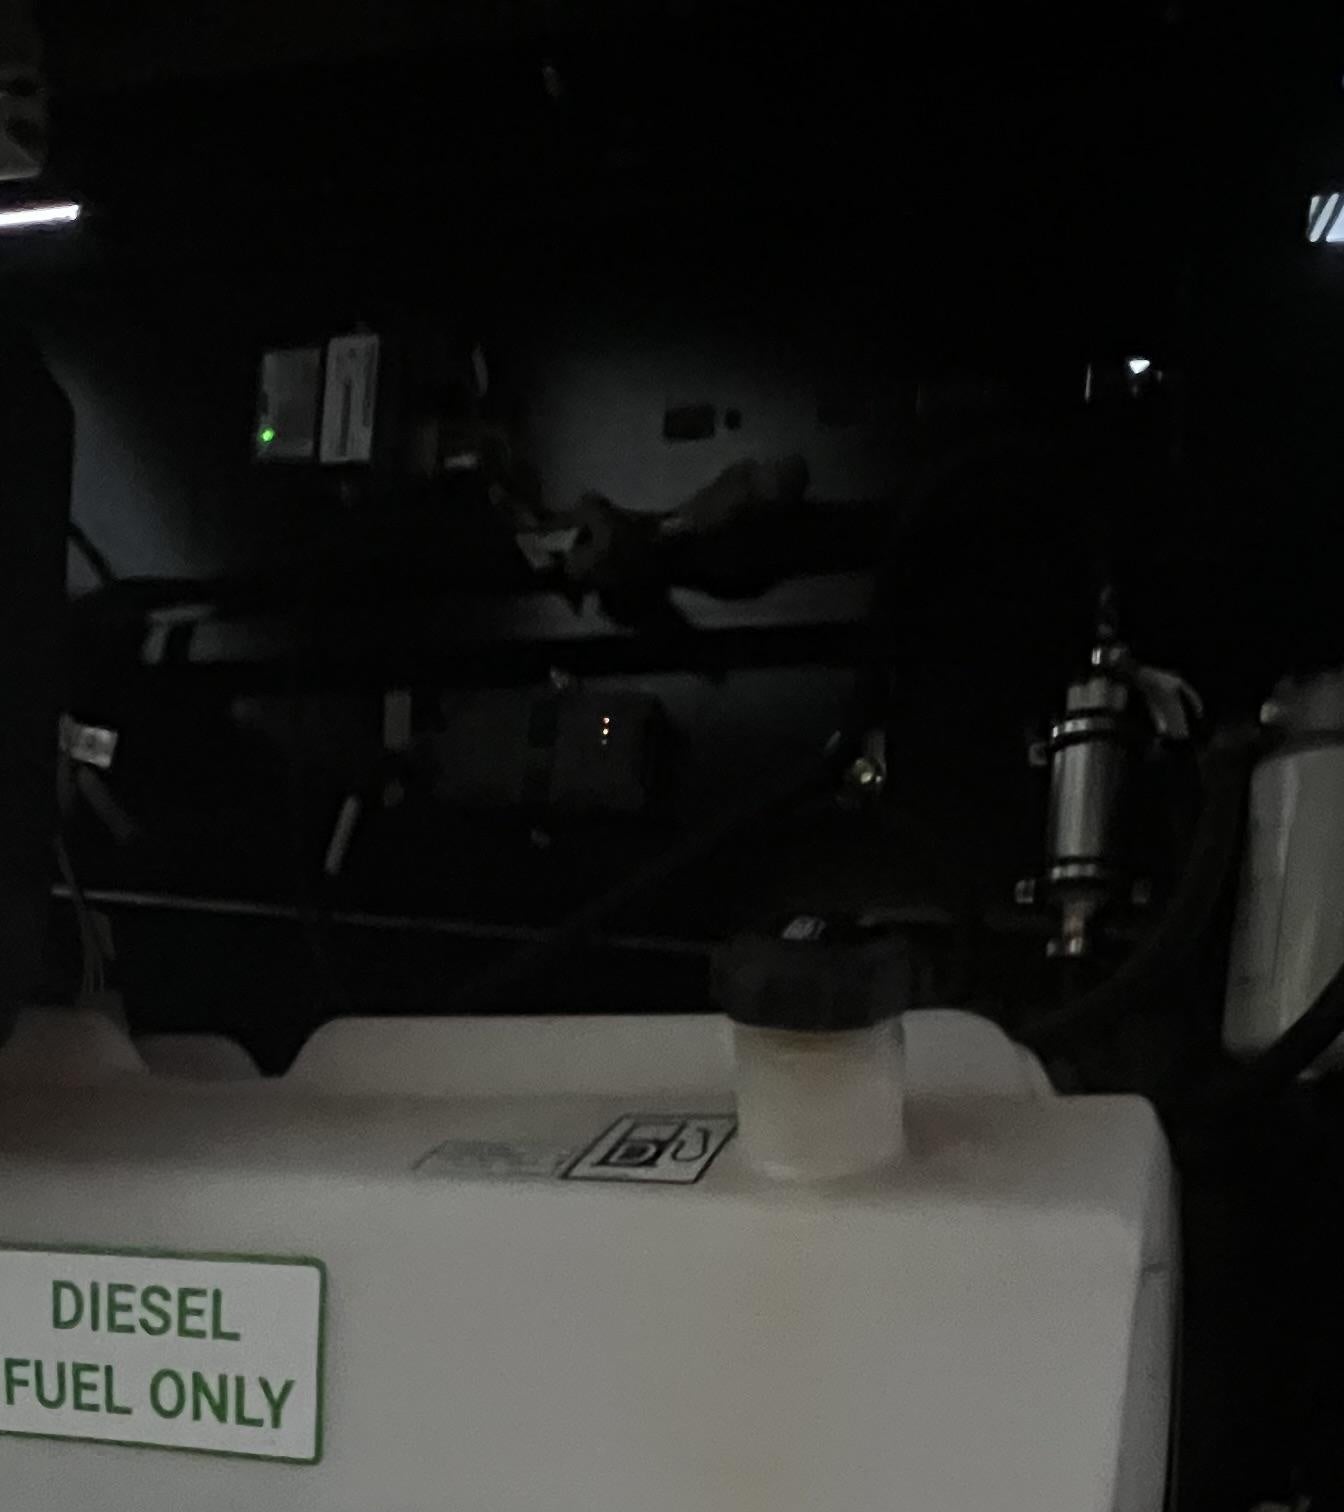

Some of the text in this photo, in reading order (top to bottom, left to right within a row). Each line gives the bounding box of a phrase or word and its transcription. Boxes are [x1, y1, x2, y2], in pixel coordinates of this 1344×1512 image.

[52, 1280, 241, 1341] DIESEL
[4, 1357, 295, 1429] FUEL ONLY
